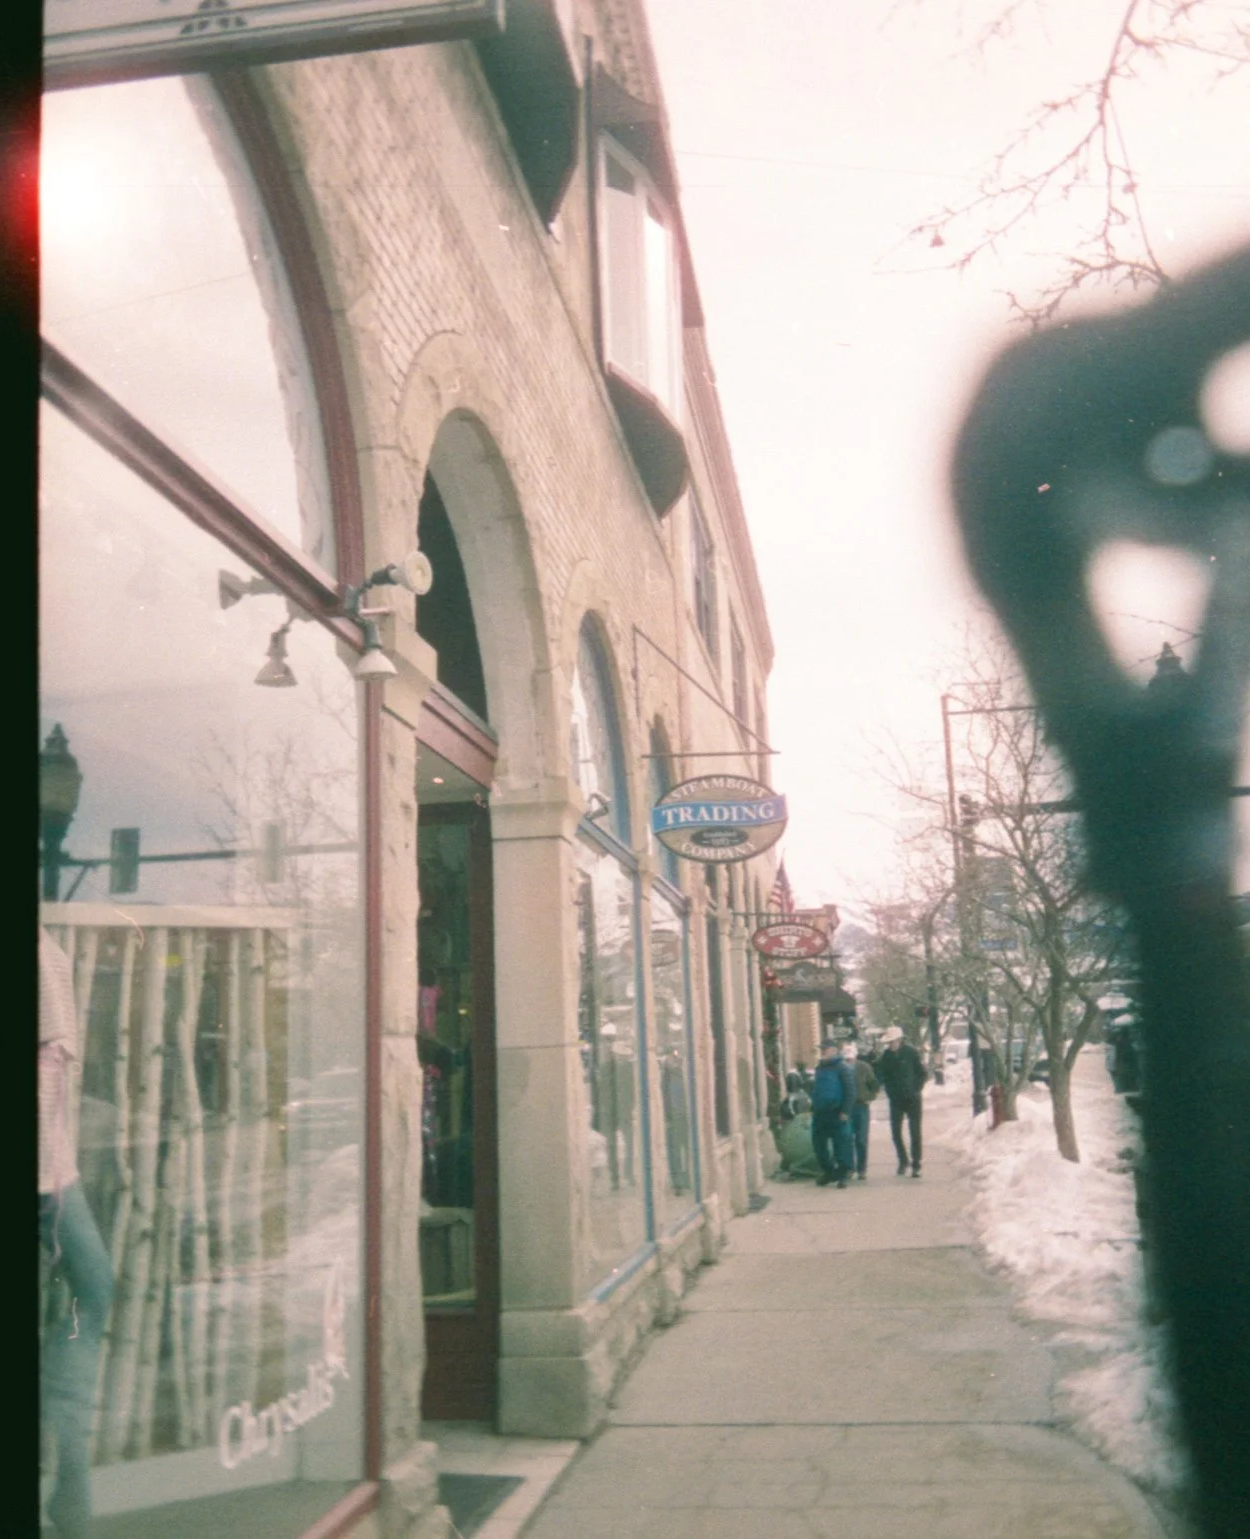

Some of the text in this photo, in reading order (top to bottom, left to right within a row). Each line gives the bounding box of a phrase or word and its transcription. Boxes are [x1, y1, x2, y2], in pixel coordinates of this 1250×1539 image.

[671, 778, 767, 800] STEAMBOAT
[662, 804, 774, 824] TRADING
[680, 841, 757, 859] COMPANY
